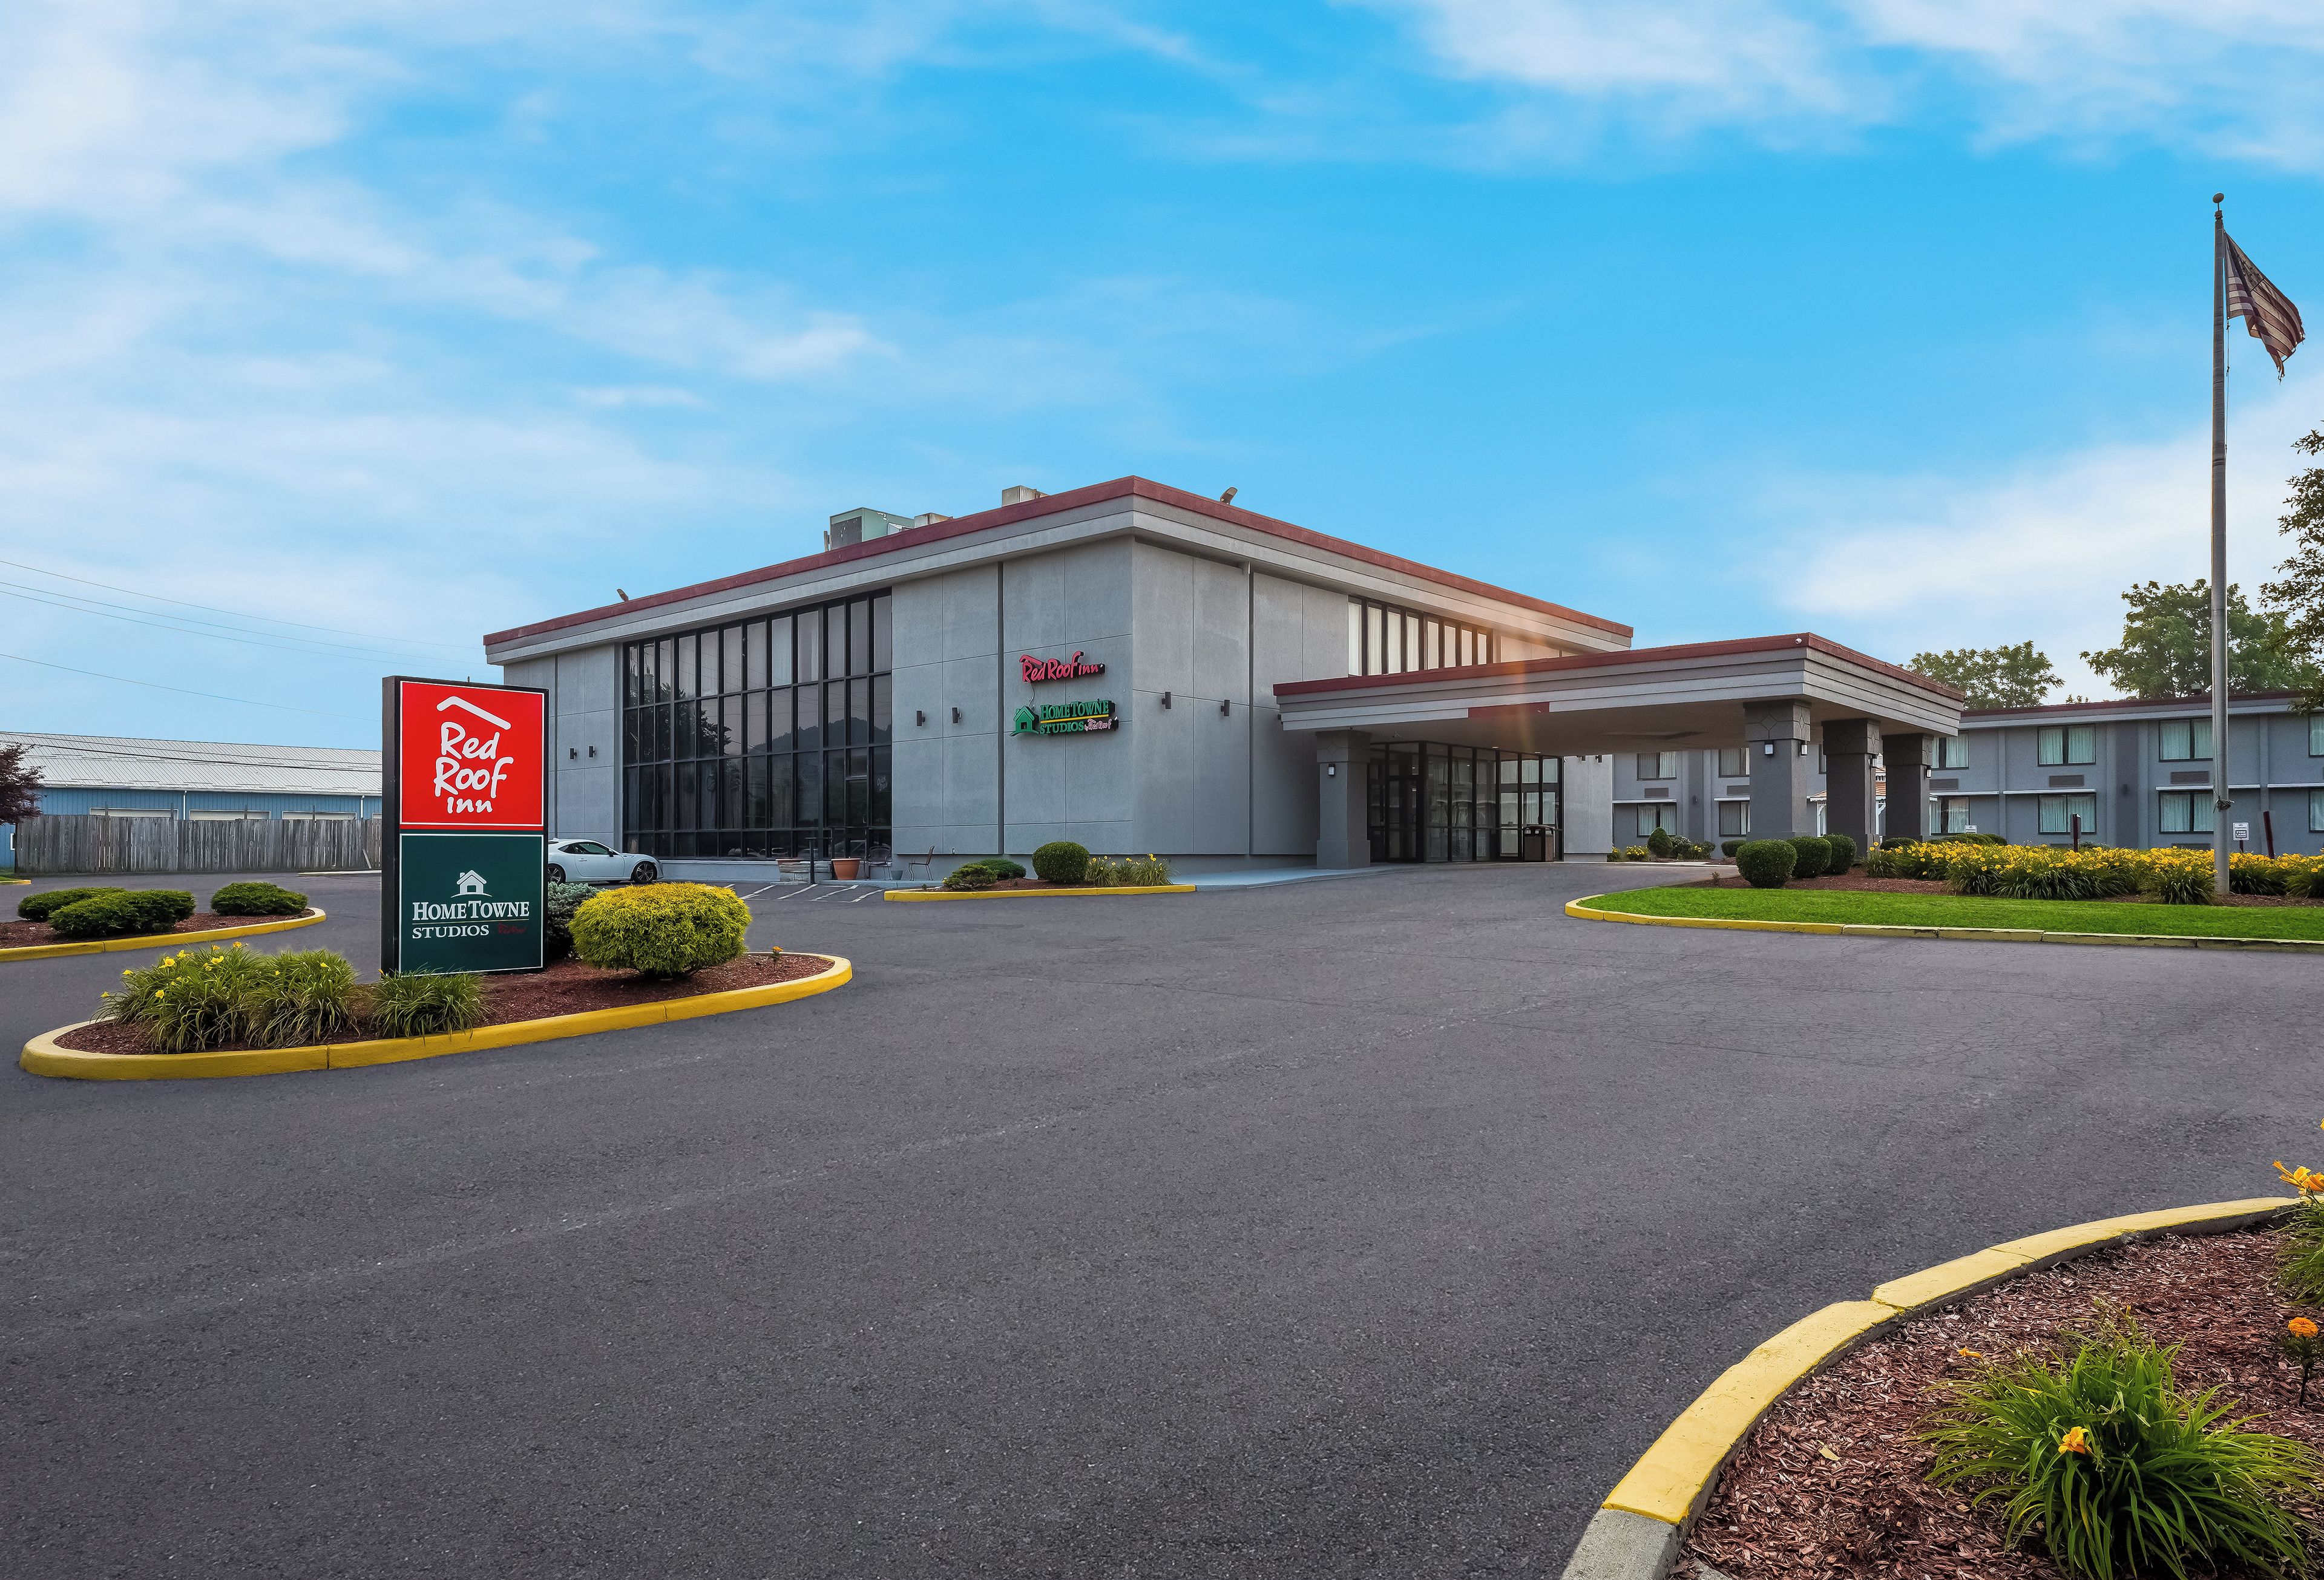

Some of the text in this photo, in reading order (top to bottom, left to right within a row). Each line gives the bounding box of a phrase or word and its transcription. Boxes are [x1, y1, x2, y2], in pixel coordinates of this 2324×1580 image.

[1022, 661, 1046, 683] Red
[1048, 651, 1082, 680] Roof
[441, 721, 500, 759] Red
[1040, 720, 1085, 734] STUDIOS
[1088, 721, 1098, 730] Red
[1098, 718, 1112, 729] Roof
[433, 756, 514, 798] Roof
[412, 925, 489, 939] STUDIOS
